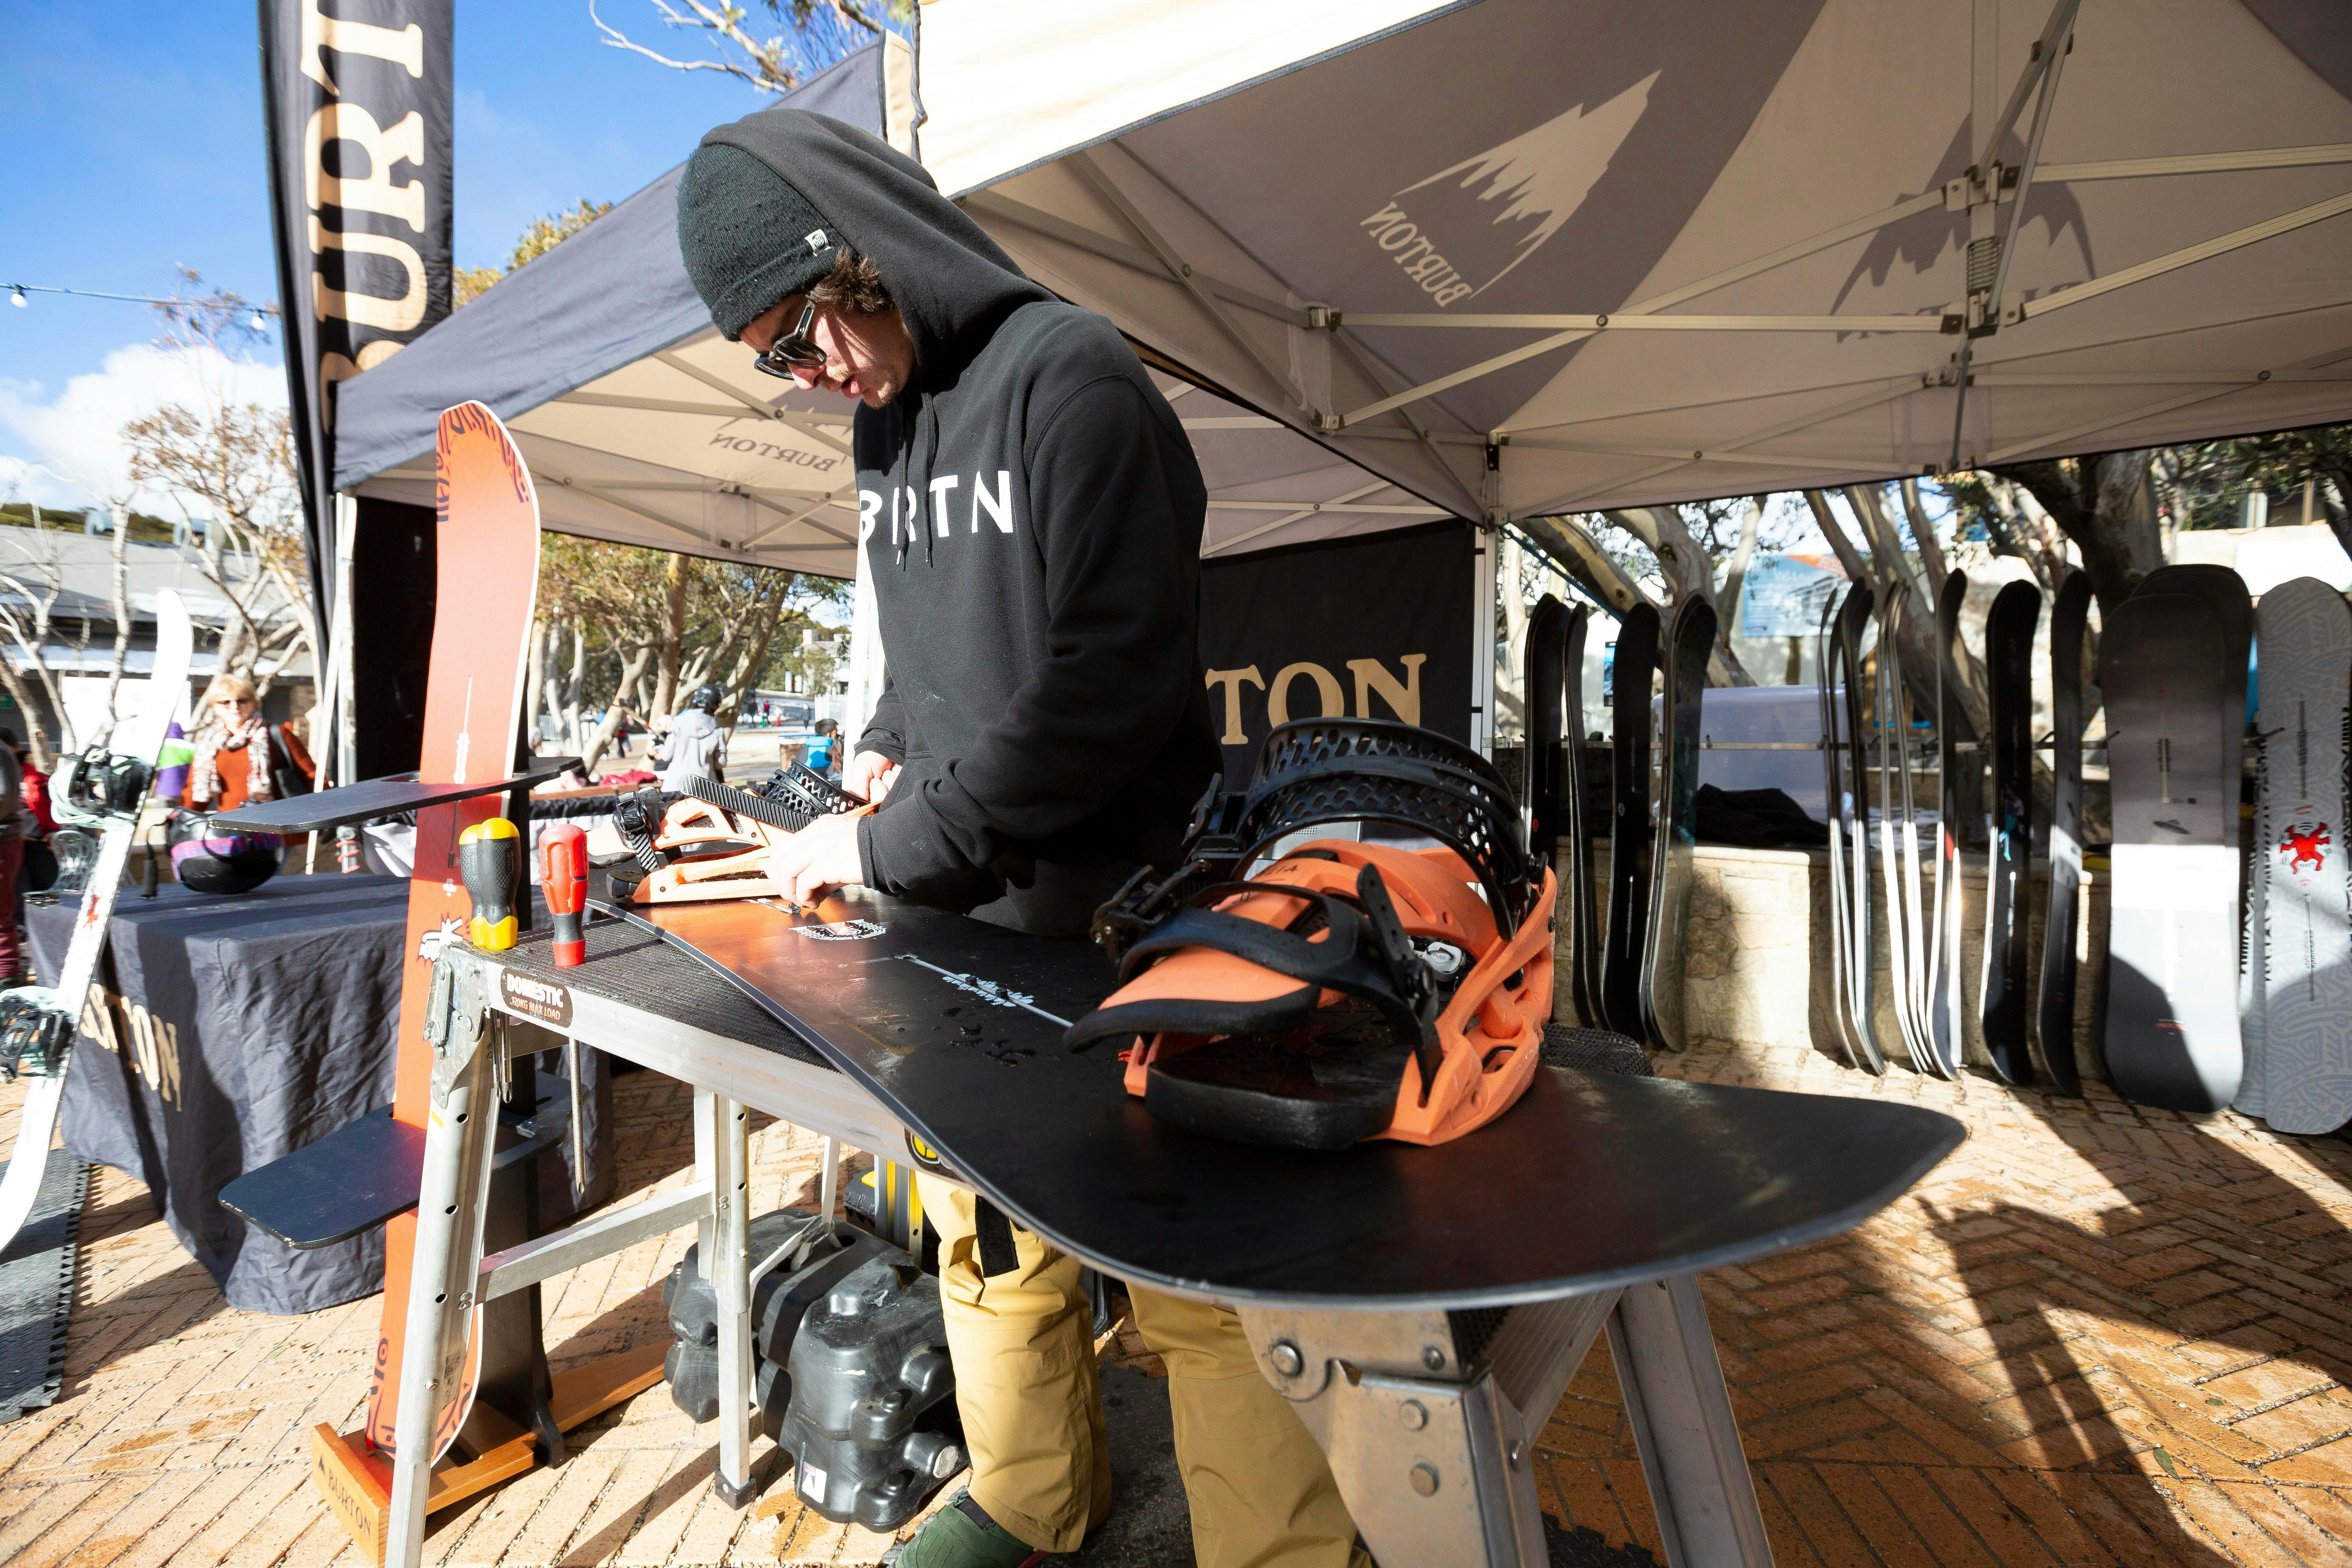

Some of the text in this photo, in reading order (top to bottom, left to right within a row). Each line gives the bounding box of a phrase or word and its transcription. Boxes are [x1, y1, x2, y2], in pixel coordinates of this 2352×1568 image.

[859, 470, 1013, 545] BRTN
[1205, 653, 1426, 745] TON
[507, 973, 564, 1008] DOMESTIC
[529, 1002, 543, 1015] MAX
[544, 1007, 561, 1020] LOAD
[328, 1468, 371, 1541] BURTON
